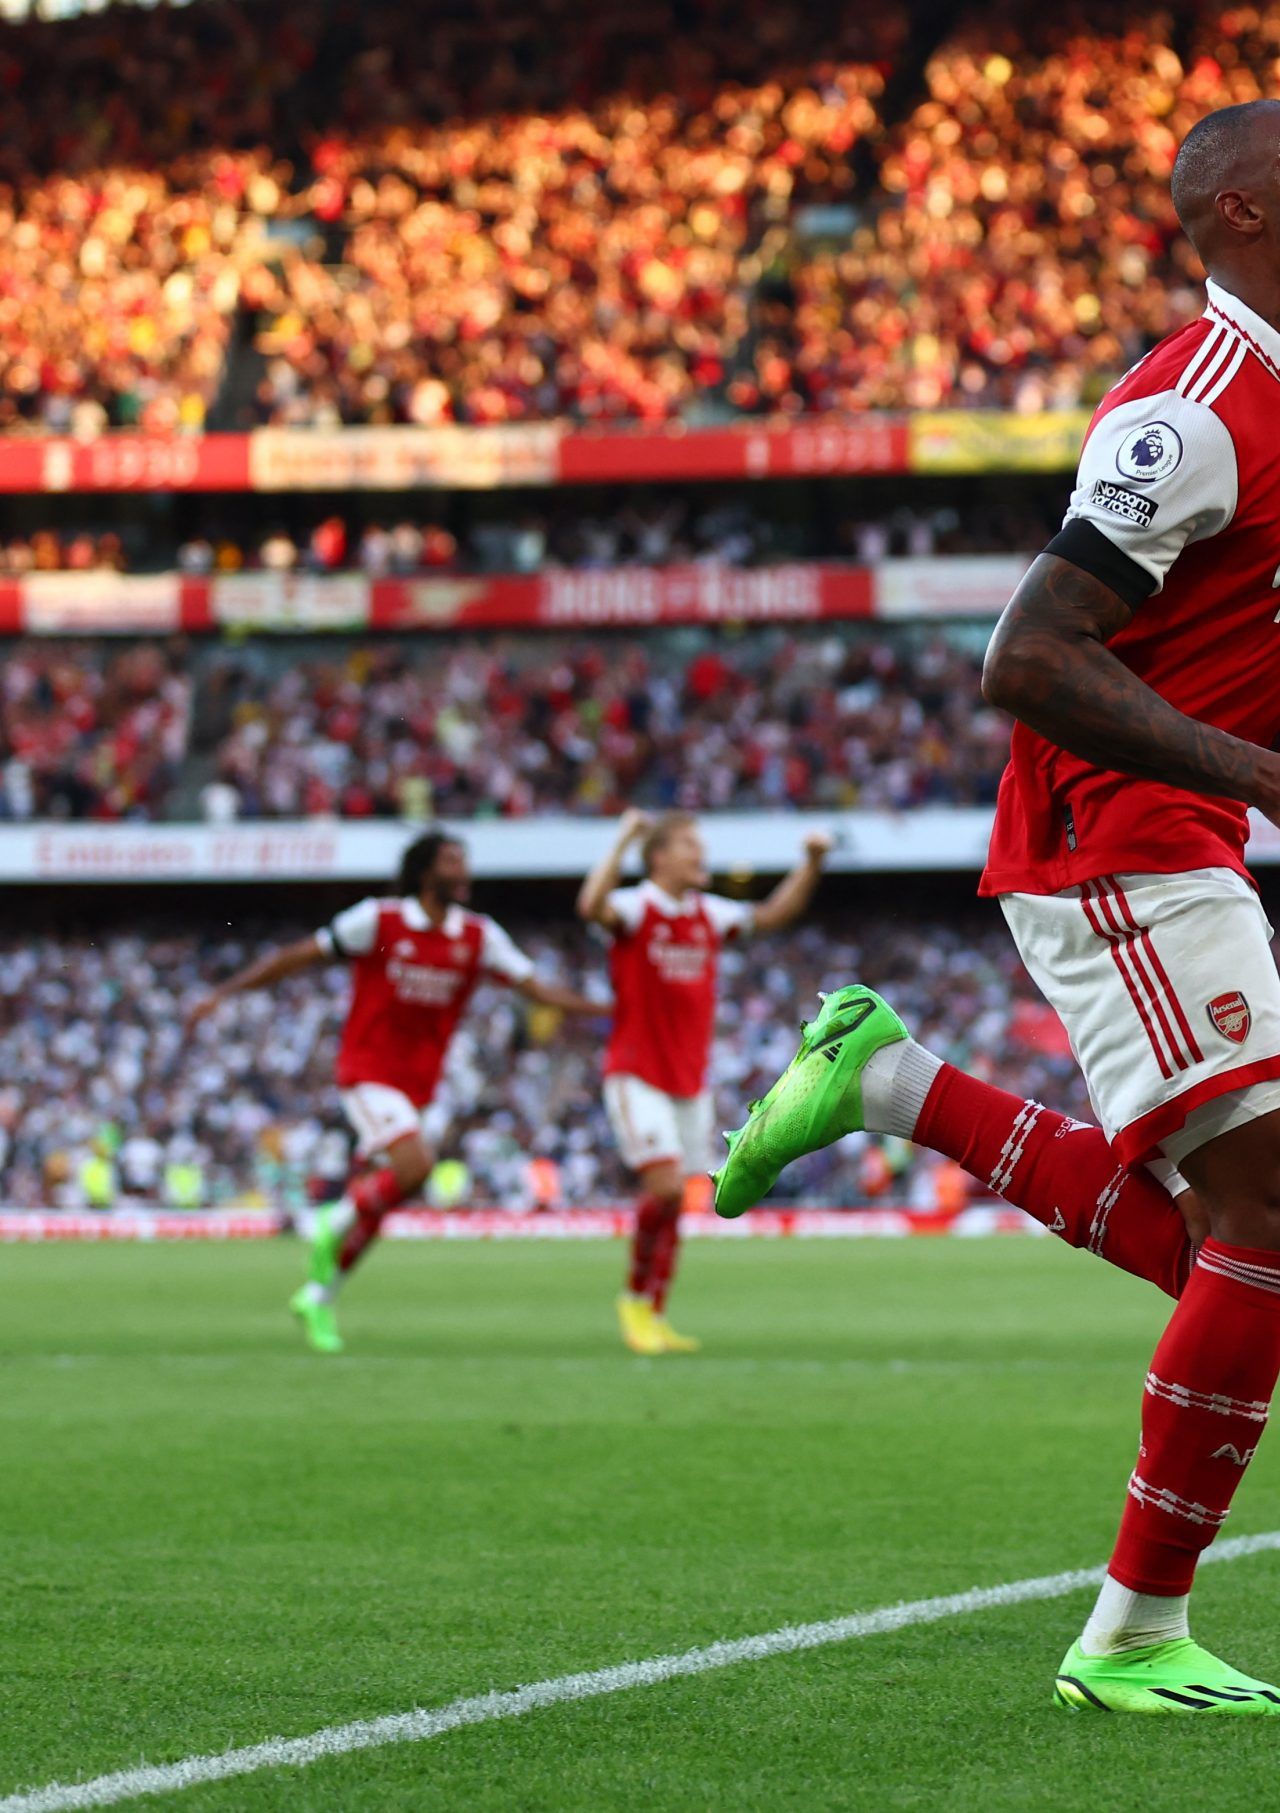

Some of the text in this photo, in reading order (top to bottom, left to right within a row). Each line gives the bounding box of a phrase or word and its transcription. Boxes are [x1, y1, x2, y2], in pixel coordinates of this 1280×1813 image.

[1136, 454, 1173, 477] Premier League
[1096, 480, 1151, 513] No room
[1107, 500, 1151, 527] racism
[1213, 997, 1242, 1015] Arsenal
